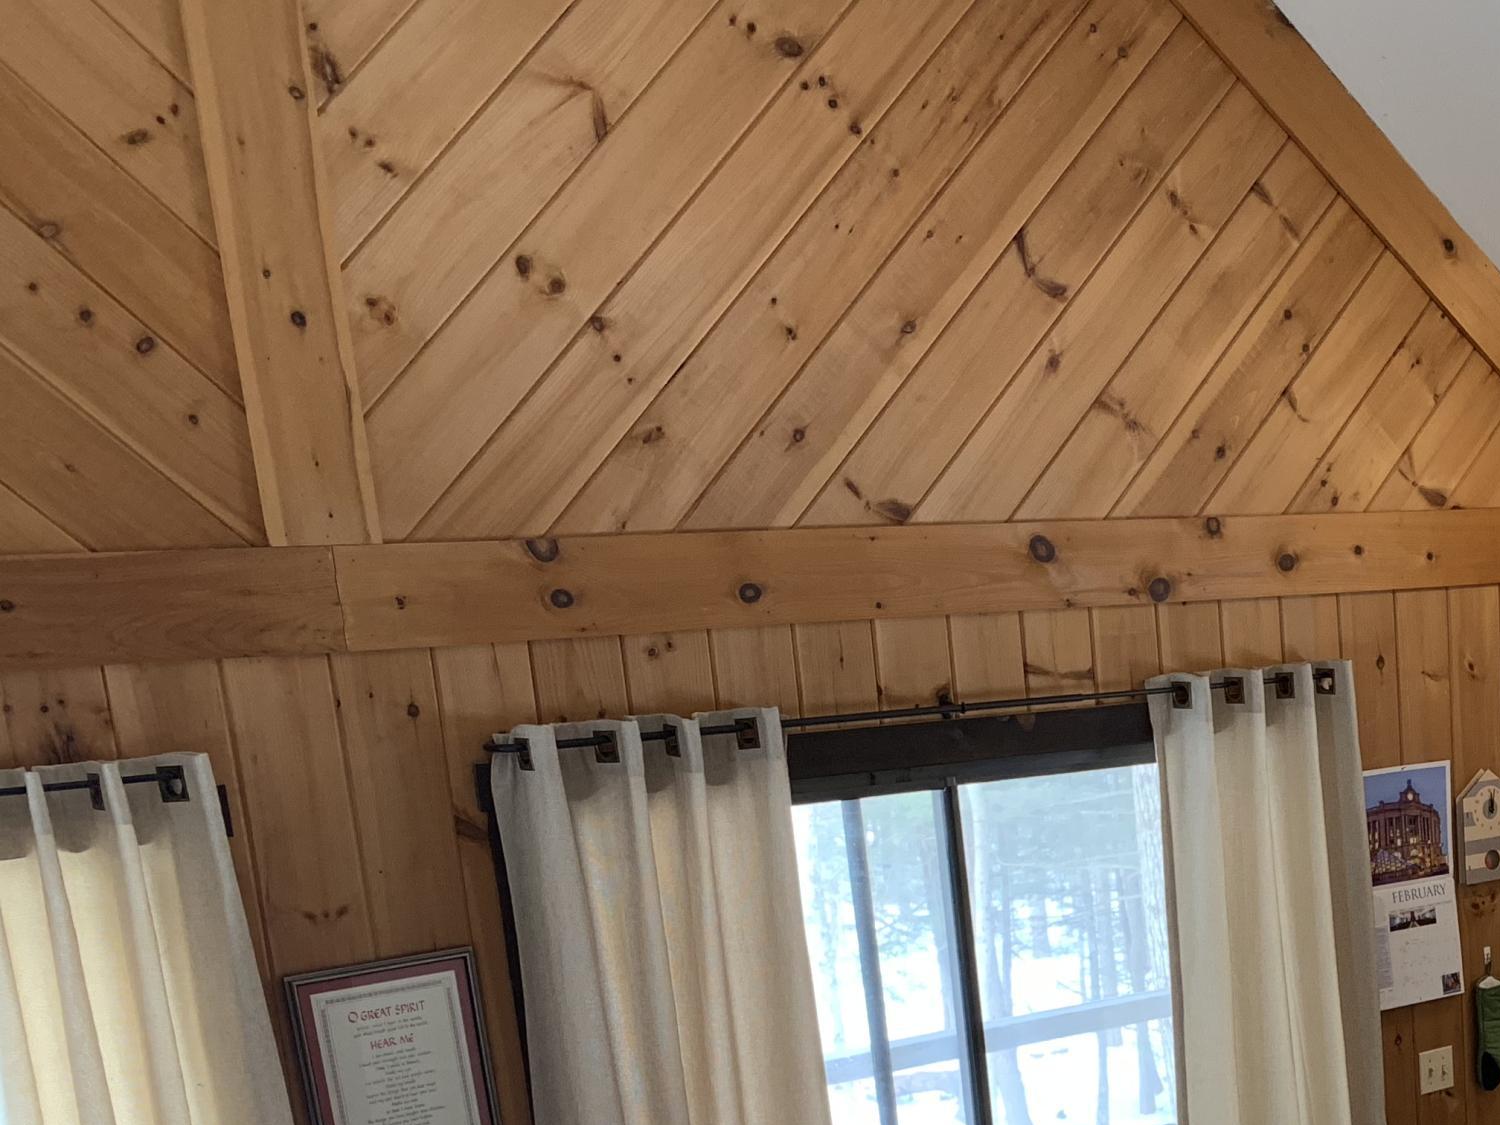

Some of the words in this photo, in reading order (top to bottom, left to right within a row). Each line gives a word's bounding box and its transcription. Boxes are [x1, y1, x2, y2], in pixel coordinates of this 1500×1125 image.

[1391, 883, 1446, 903] FEBRUARY
[360, 1006, 392, 1021] GREAT
[394, 1000, 425, 1015] SPIRIT
[370, 1037, 397, 1050] HEAR
